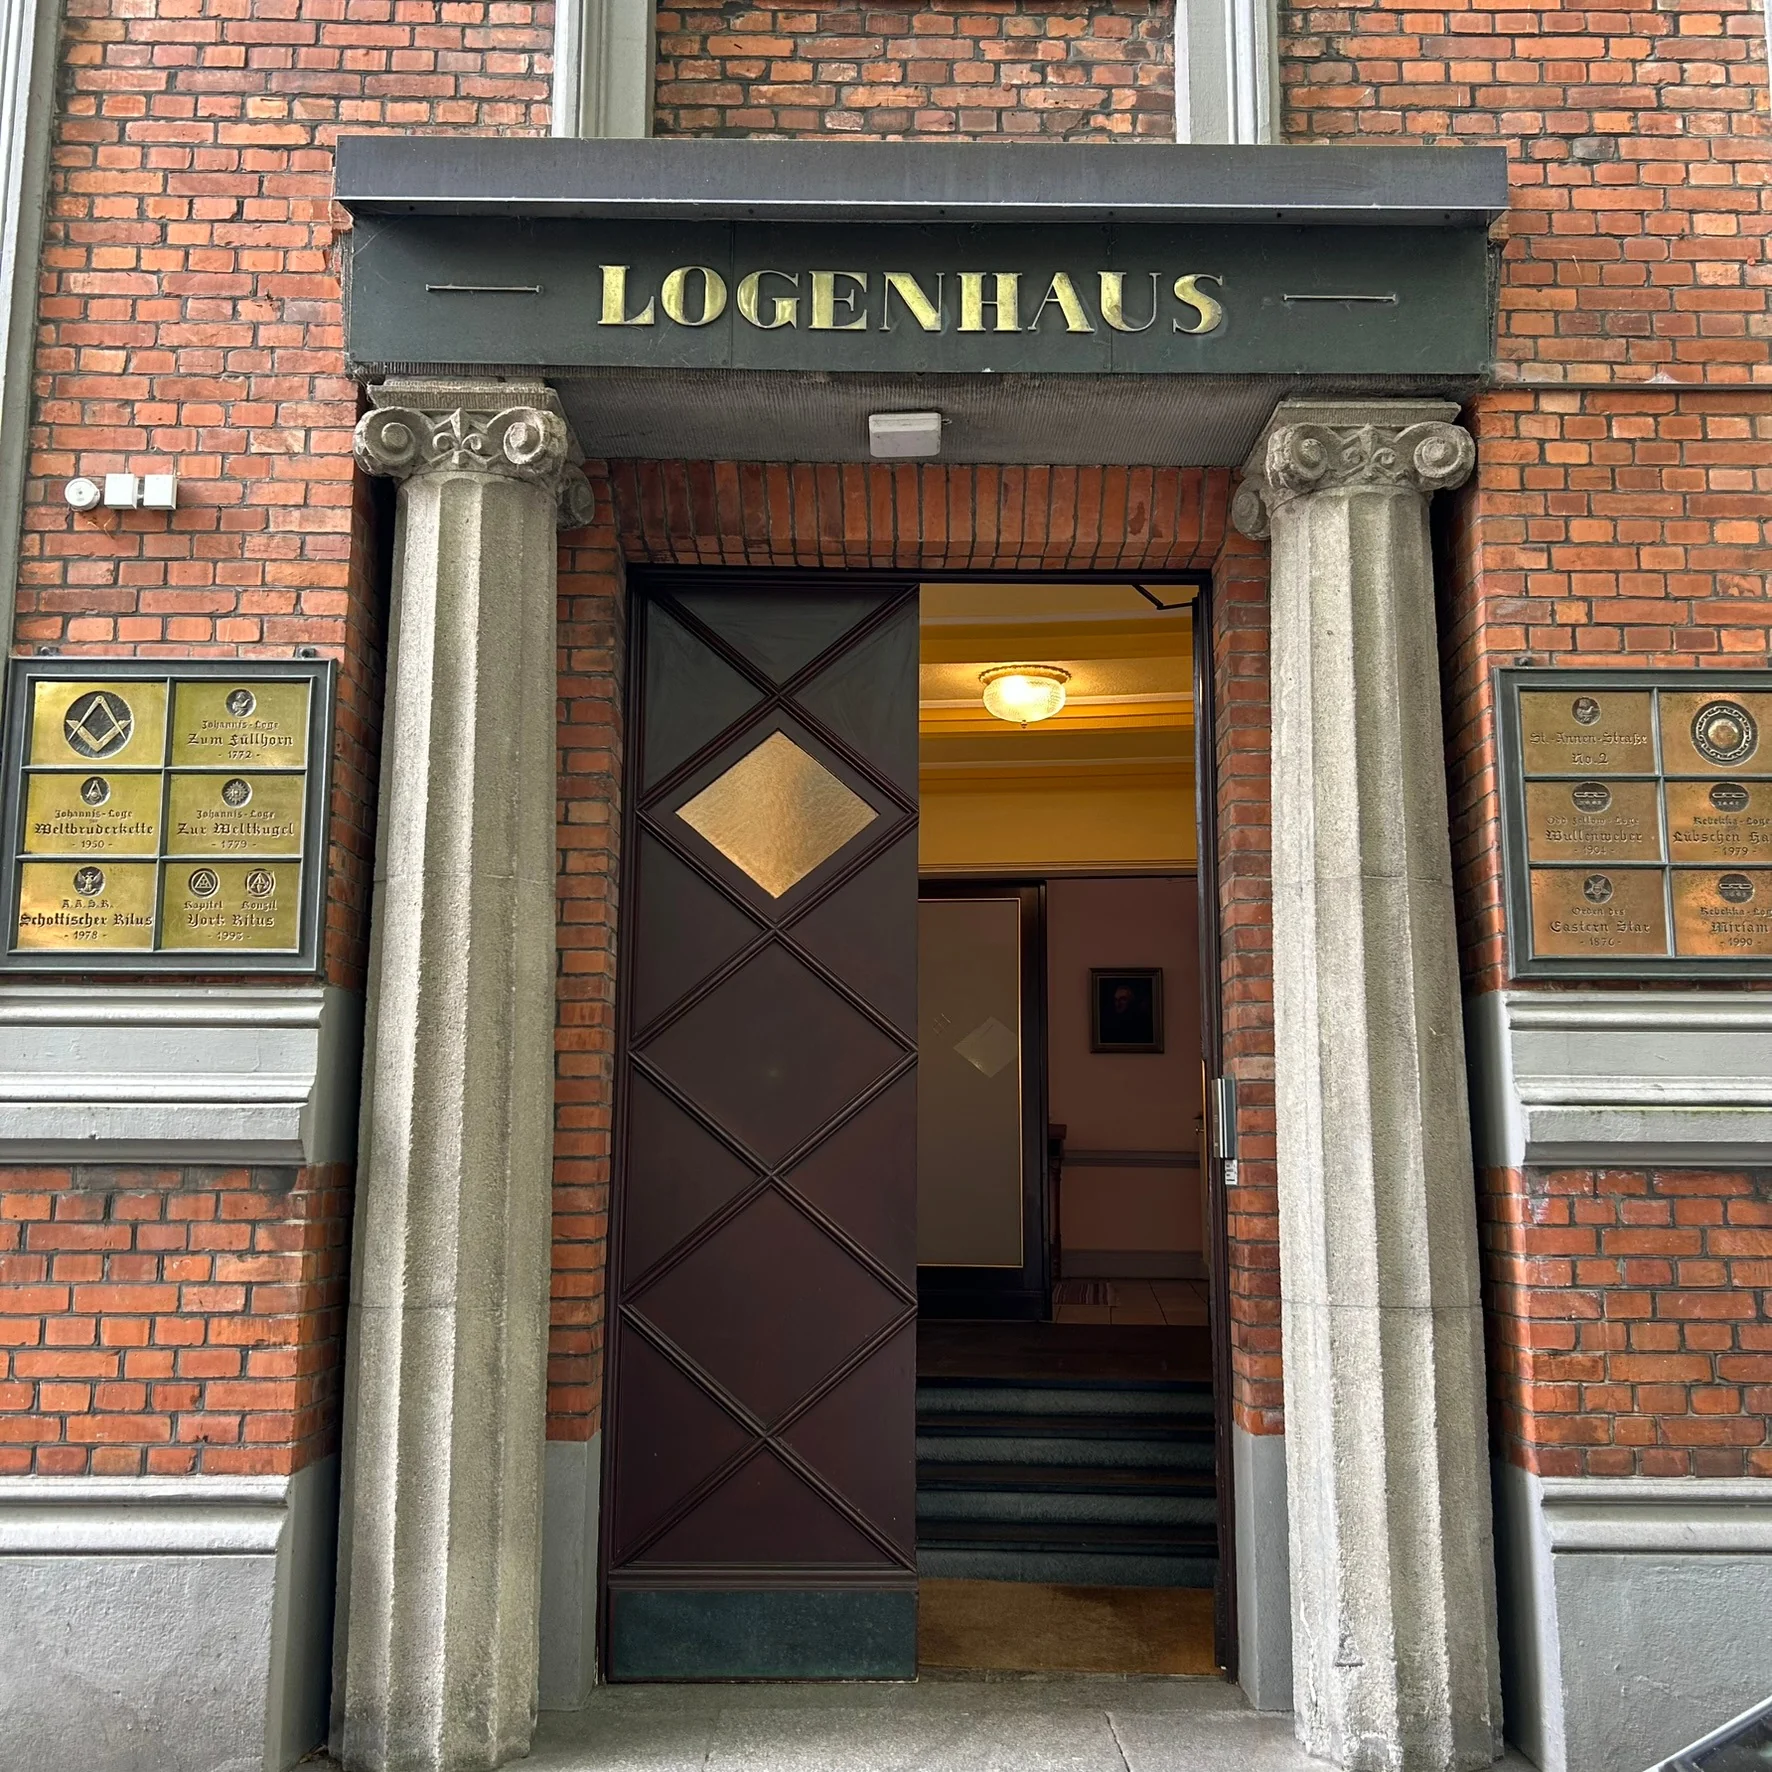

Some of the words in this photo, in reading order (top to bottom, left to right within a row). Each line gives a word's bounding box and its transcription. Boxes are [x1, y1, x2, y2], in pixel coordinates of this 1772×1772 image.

[597, 264, 1224, 334] LOGENHAUS
[187, 733, 223, 745] Zum
[229, 733, 293, 747] Füllhorn
[35, 823, 154, 835] Weltbruderkette
[177, 823, 207, 835] Zur
[213, 822, 295, 837] Weltkugel
[1672, 829, 1741, 844] Lübschen
[183, 900, 224, 911] Kapitel
[241, 900, 277, 911] Konzil
[1571, 907, 1604, 917] Orden
[1608, 907, 1625, 917] des
[19, 912, 108, 928] Schottischer
[113, 913, 153, 926] Ritus
[187, 913, 226, 928] York
[232, 913, 275, 927] Ritus
[1550, 920, 1610, 933] Eastern
[1616, 920, 1651, 933] Star
[1710, 921, 1769, 934] Miriam
